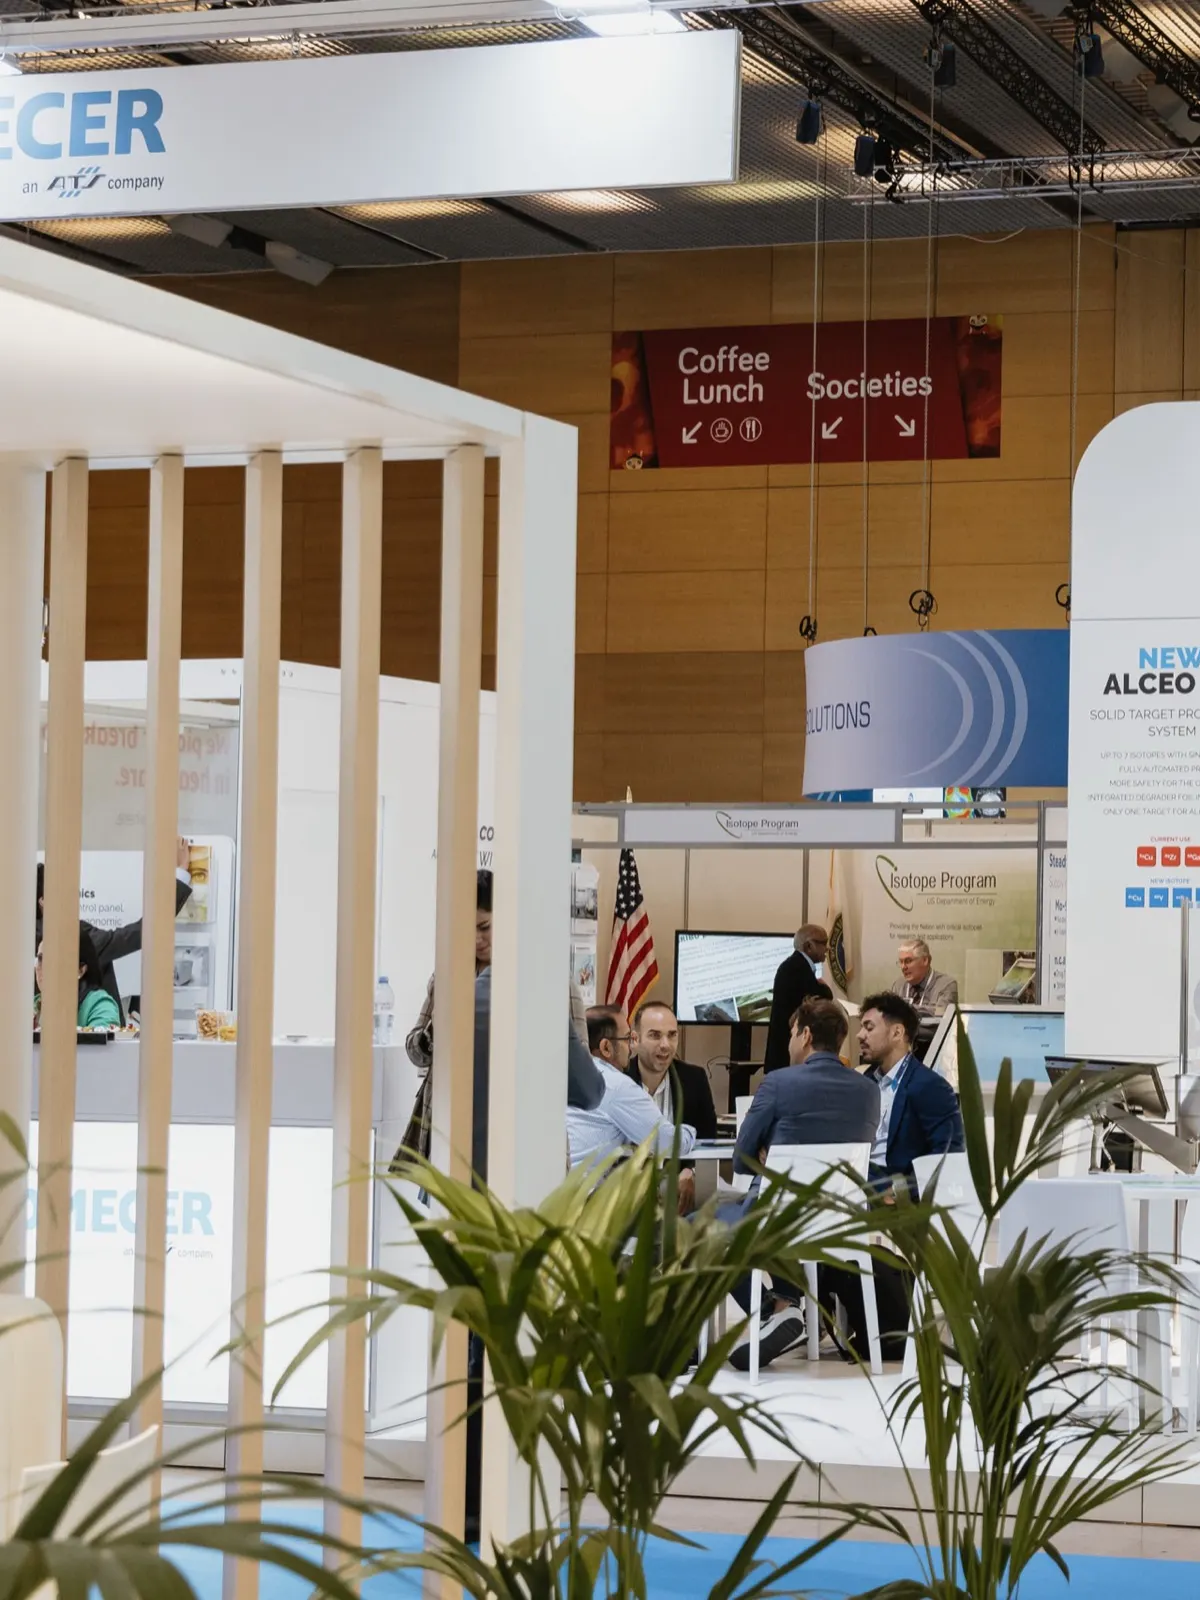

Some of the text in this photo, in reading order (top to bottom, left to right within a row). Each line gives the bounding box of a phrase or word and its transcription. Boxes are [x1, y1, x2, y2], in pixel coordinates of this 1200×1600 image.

[22, 181, 38, 193] an
[107, 175, 165, 191] company
[678, 345, 770, 375] Coffee
[683, 375, 764, 405] Lunch
[806, 371, 933, 400] Societies
[1103, 672, 1196, 695] ALCEO
[1090, 709, 1125, 721] SOLID
[1128, 709, 1175, 720] TARGET
[1148, 726, 1197, 737] SYSTEM
[726, 818, 799, 830] Isotope Program
[890, 871, 997, 893] Isotope Program
